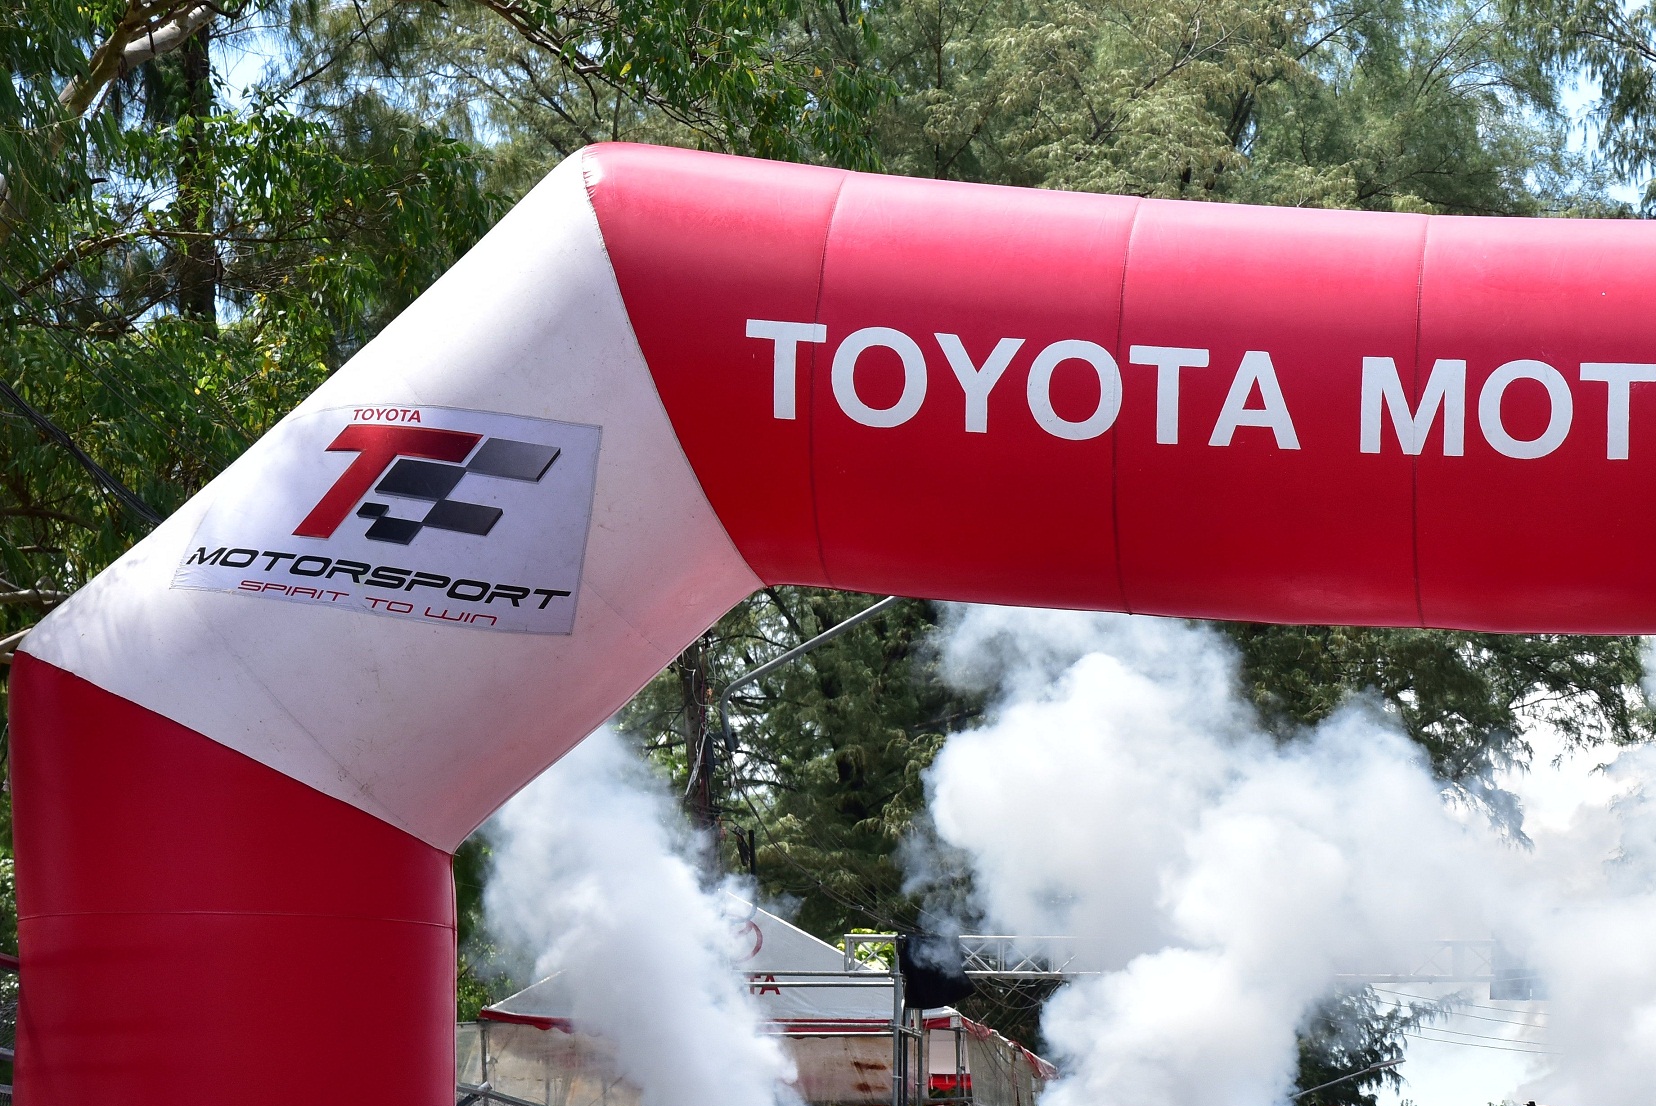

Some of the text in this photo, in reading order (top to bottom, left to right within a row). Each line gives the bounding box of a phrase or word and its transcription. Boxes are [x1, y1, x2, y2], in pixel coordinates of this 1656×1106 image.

[746, 318, 1300, 451] TOYOTA
[352, 407, 421, 423] TOYOTA
[187, 546, 570, 610] MOTORSPORT
[237, 580, 498, 626] SPIRIT TO WIN
